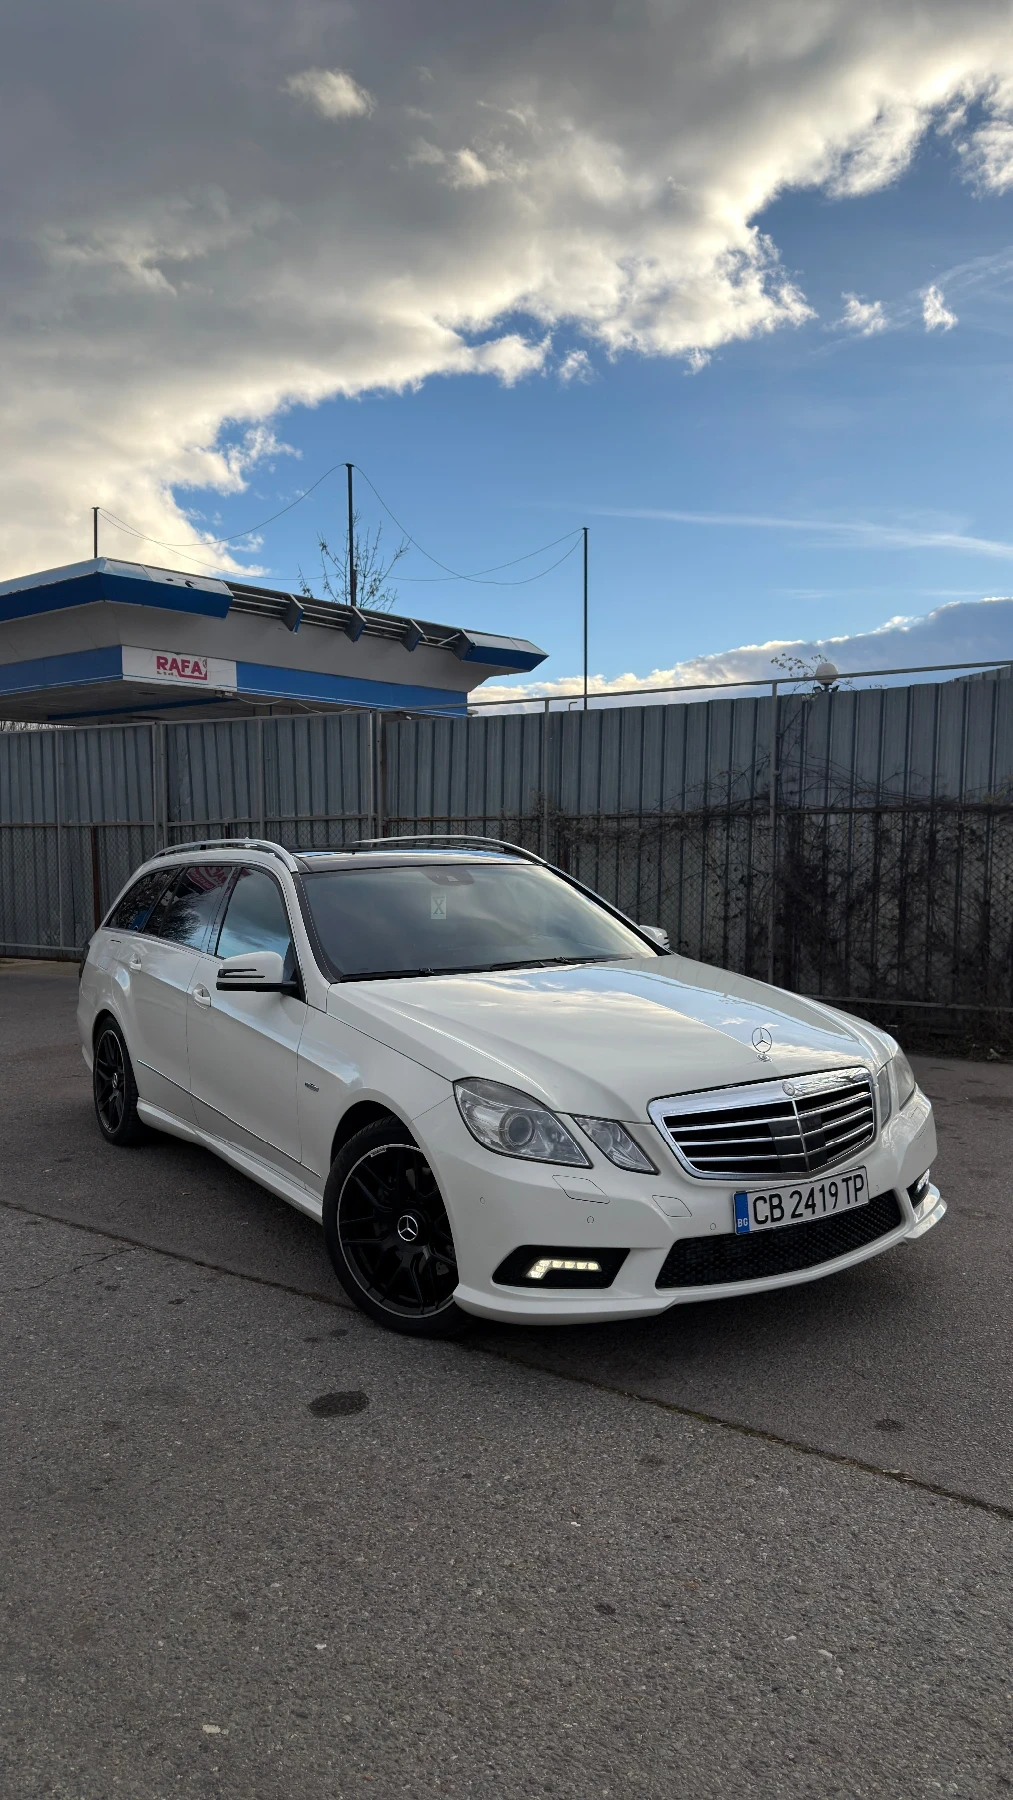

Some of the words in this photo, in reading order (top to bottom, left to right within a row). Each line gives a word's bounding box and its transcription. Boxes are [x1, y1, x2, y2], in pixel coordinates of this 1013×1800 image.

[156, 656, 204, 678] RAFA
[752, 1193, 785, 1225] CB
[789, 1181, 838, 1219] 2419
[842, 1173, 865, 1205] TP
[737, 1218, 749, 1228] BG
